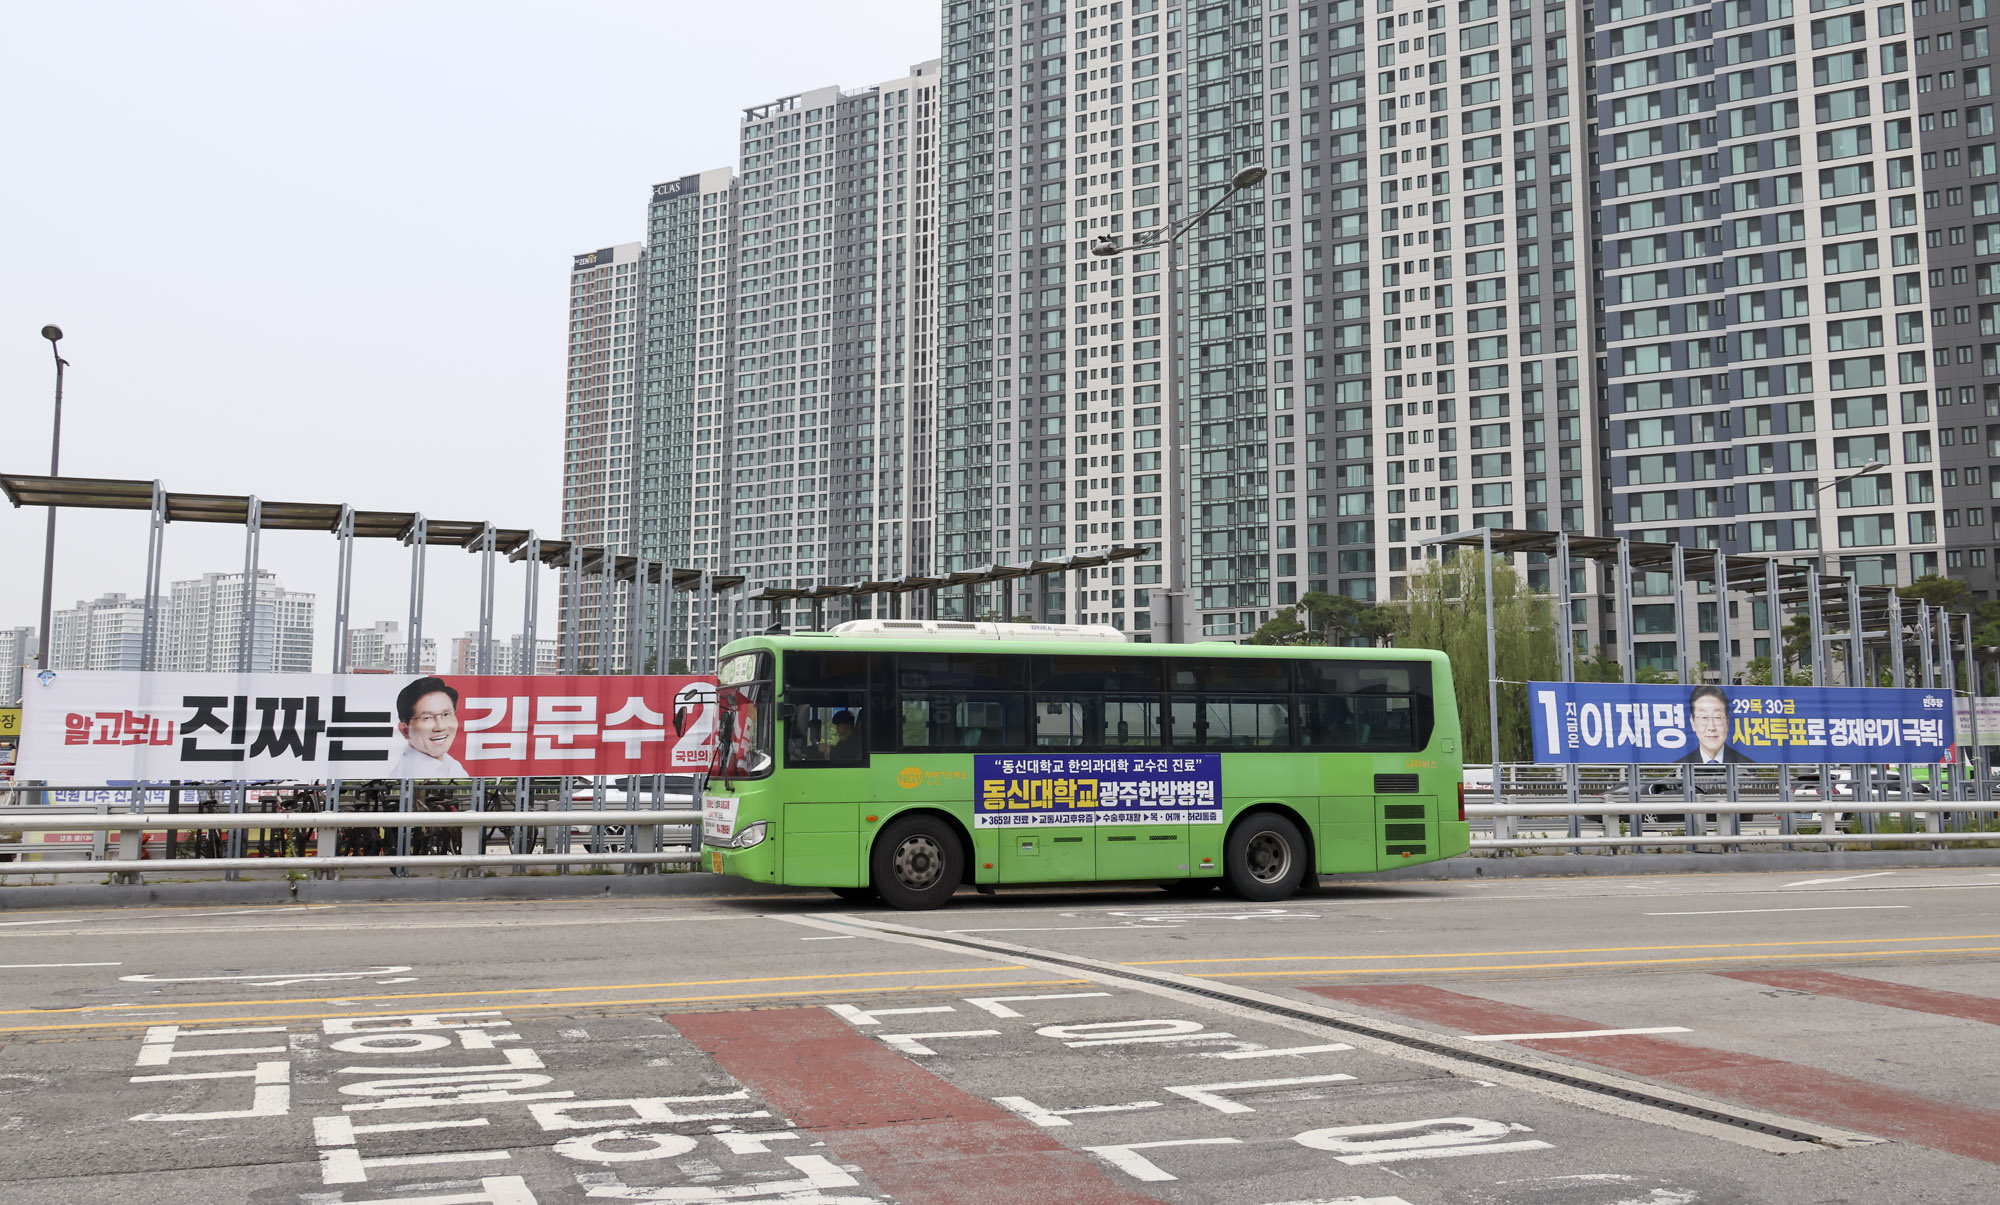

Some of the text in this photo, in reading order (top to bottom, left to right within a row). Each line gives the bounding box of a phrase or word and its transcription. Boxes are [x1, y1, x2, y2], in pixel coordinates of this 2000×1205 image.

[1733, 699, 1796, 715] 29목 30금
[1923, 698, 1944, 708] 민주당
[0, 714, 16, 729] 장
[65, 695, 665, 762] 알고보니 진짜는 김문수
[671, 682, 719, 766] 2
[1536, 689, 1561, 755] 1
[1565, 701, 1580, 749] 지금은
[1580, 702, 1686, 749] 이재명
[1733, 718, 1944, 747] 사전투표로 경제위기 극복!
[675, 750, 720, 763] 국민의
[994, 758, 1202, 774] “동신대학교 한의과대학 교수진 진료”
[899, 773, 924, 784] NGV
[114, 789, 165, 803] 신지역
[988, 815, 1011, 825] 365일
[1013, 815, 1030, 824] 진료
[1039, 814, 1093, 824] 교통사고후유증
[1150, 812, 1158, 822] 목
[1188, 811, 1217, 821] 허리통증
